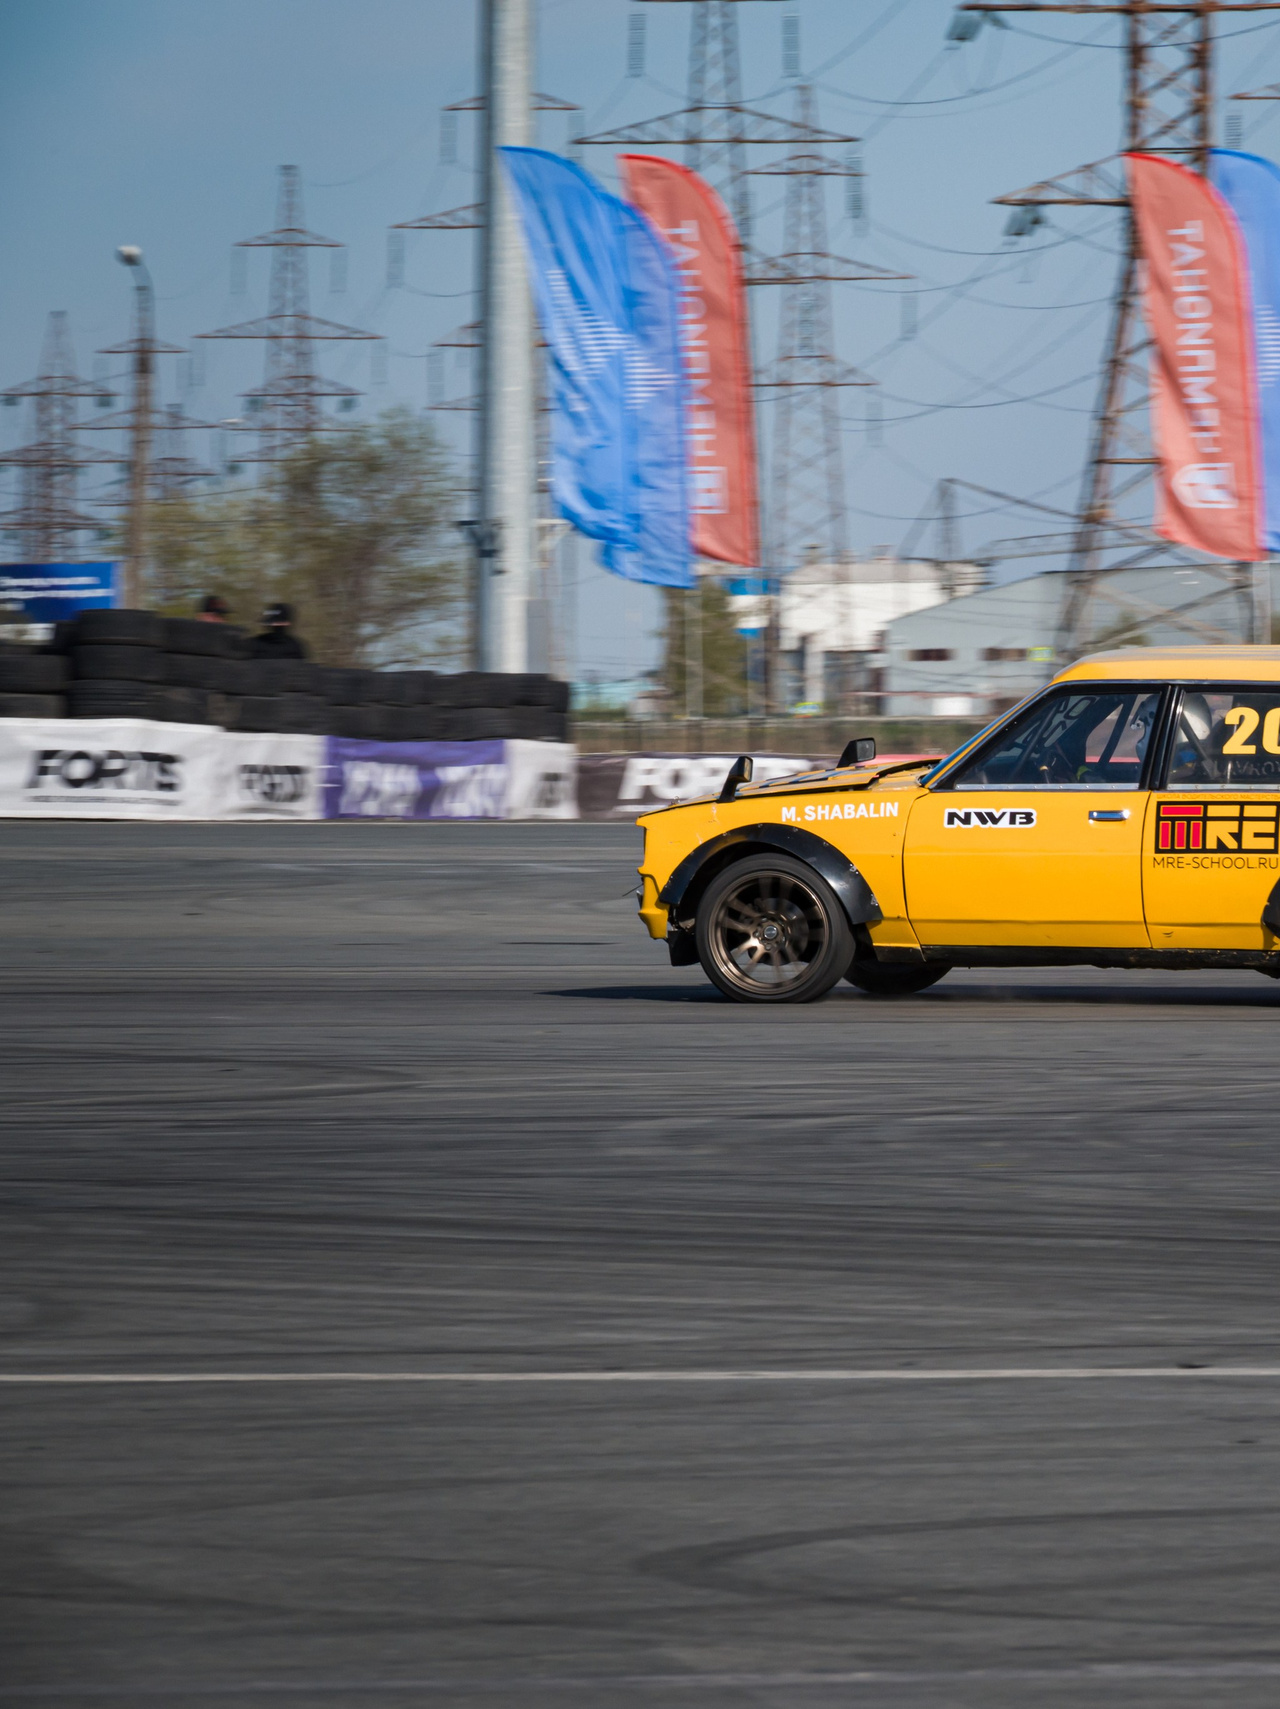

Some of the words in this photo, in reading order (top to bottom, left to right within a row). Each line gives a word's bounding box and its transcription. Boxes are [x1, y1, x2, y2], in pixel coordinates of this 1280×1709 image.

[26, 750, 184, 791] FORTS
[781, 807, 801, 823] M.
[804, 802, 899, 821] SHABALIN
[946, 810, 1036, 826] NWB
[1153, 856, 1279, 870] MRE-SCHOOL.RU
